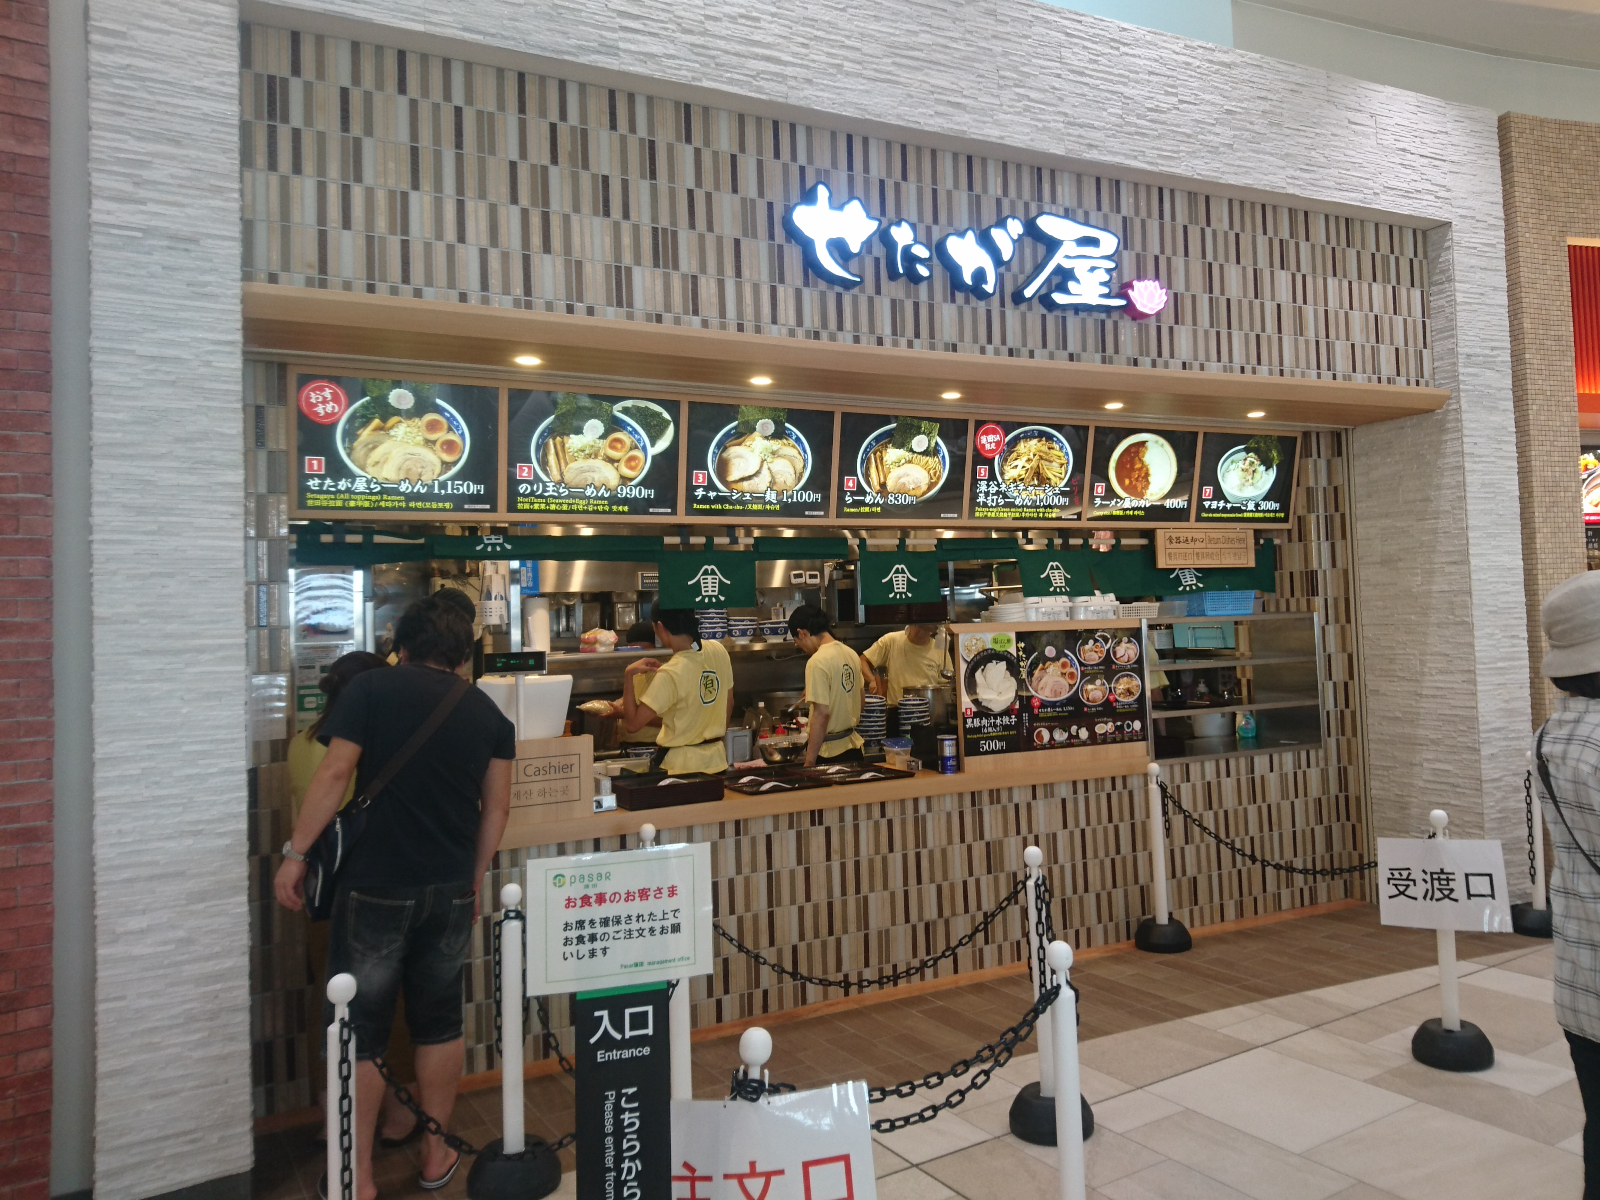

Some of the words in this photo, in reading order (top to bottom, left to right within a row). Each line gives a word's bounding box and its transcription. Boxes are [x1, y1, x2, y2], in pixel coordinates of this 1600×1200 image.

[788, 180, 1128, 311] せたが屋
[310, 460, 319, 470] 1
[521, 467, 529, 477] 2
[697, 473, 704, 483] 3
[848, 479, 854, 488] 4
[306, 477, 428, 494] せたが屋らーめん
[432, 480, 485, 496] 1,150円
[518, 483, 611, 498] のり玉らーめん
[617, 485, 655, 499] 990円
[976, 481, 1070, 495] 深谷ネギチャーシュー
[693, 487, 778, 503] チャーシュー麺
[782, 490, 822, 504] 1,100円
[845, 491, 885, 504] らーめん
[887, 493, 917, 505] 830円
[976, 493, 1032, 506] 平打らーめん
[1035, 495, 1069, 506] 1,000円
[1093, 497, 1161, 509] ラーメン屋のカレー
[1164, 499, 1188, 509] 400円
[1258, 501, 1280, 511] 300円
[980, 739, 1006, 752] 500円
[523, 761, 575, 777] Cashier
[1387, 867, 1496, 903] 受渡口
[563, 884, 679, 910] お食事のお客さま
[562, 908, 681, 932] お席を確保された上で
[562, 922, 682, 947] お食事のご注文をお願
[562, 946, 610, 961] いします
[589, 1005, 654, 1045] 入口
[596, 1046, 651, 1063] Entrance
[604, 1091, 616, 1134] Please
[620, 1087, 642, 1200] こちらから
[604, 1136, 616, 1169] enter
[605, 1171, 616, 1200] from
